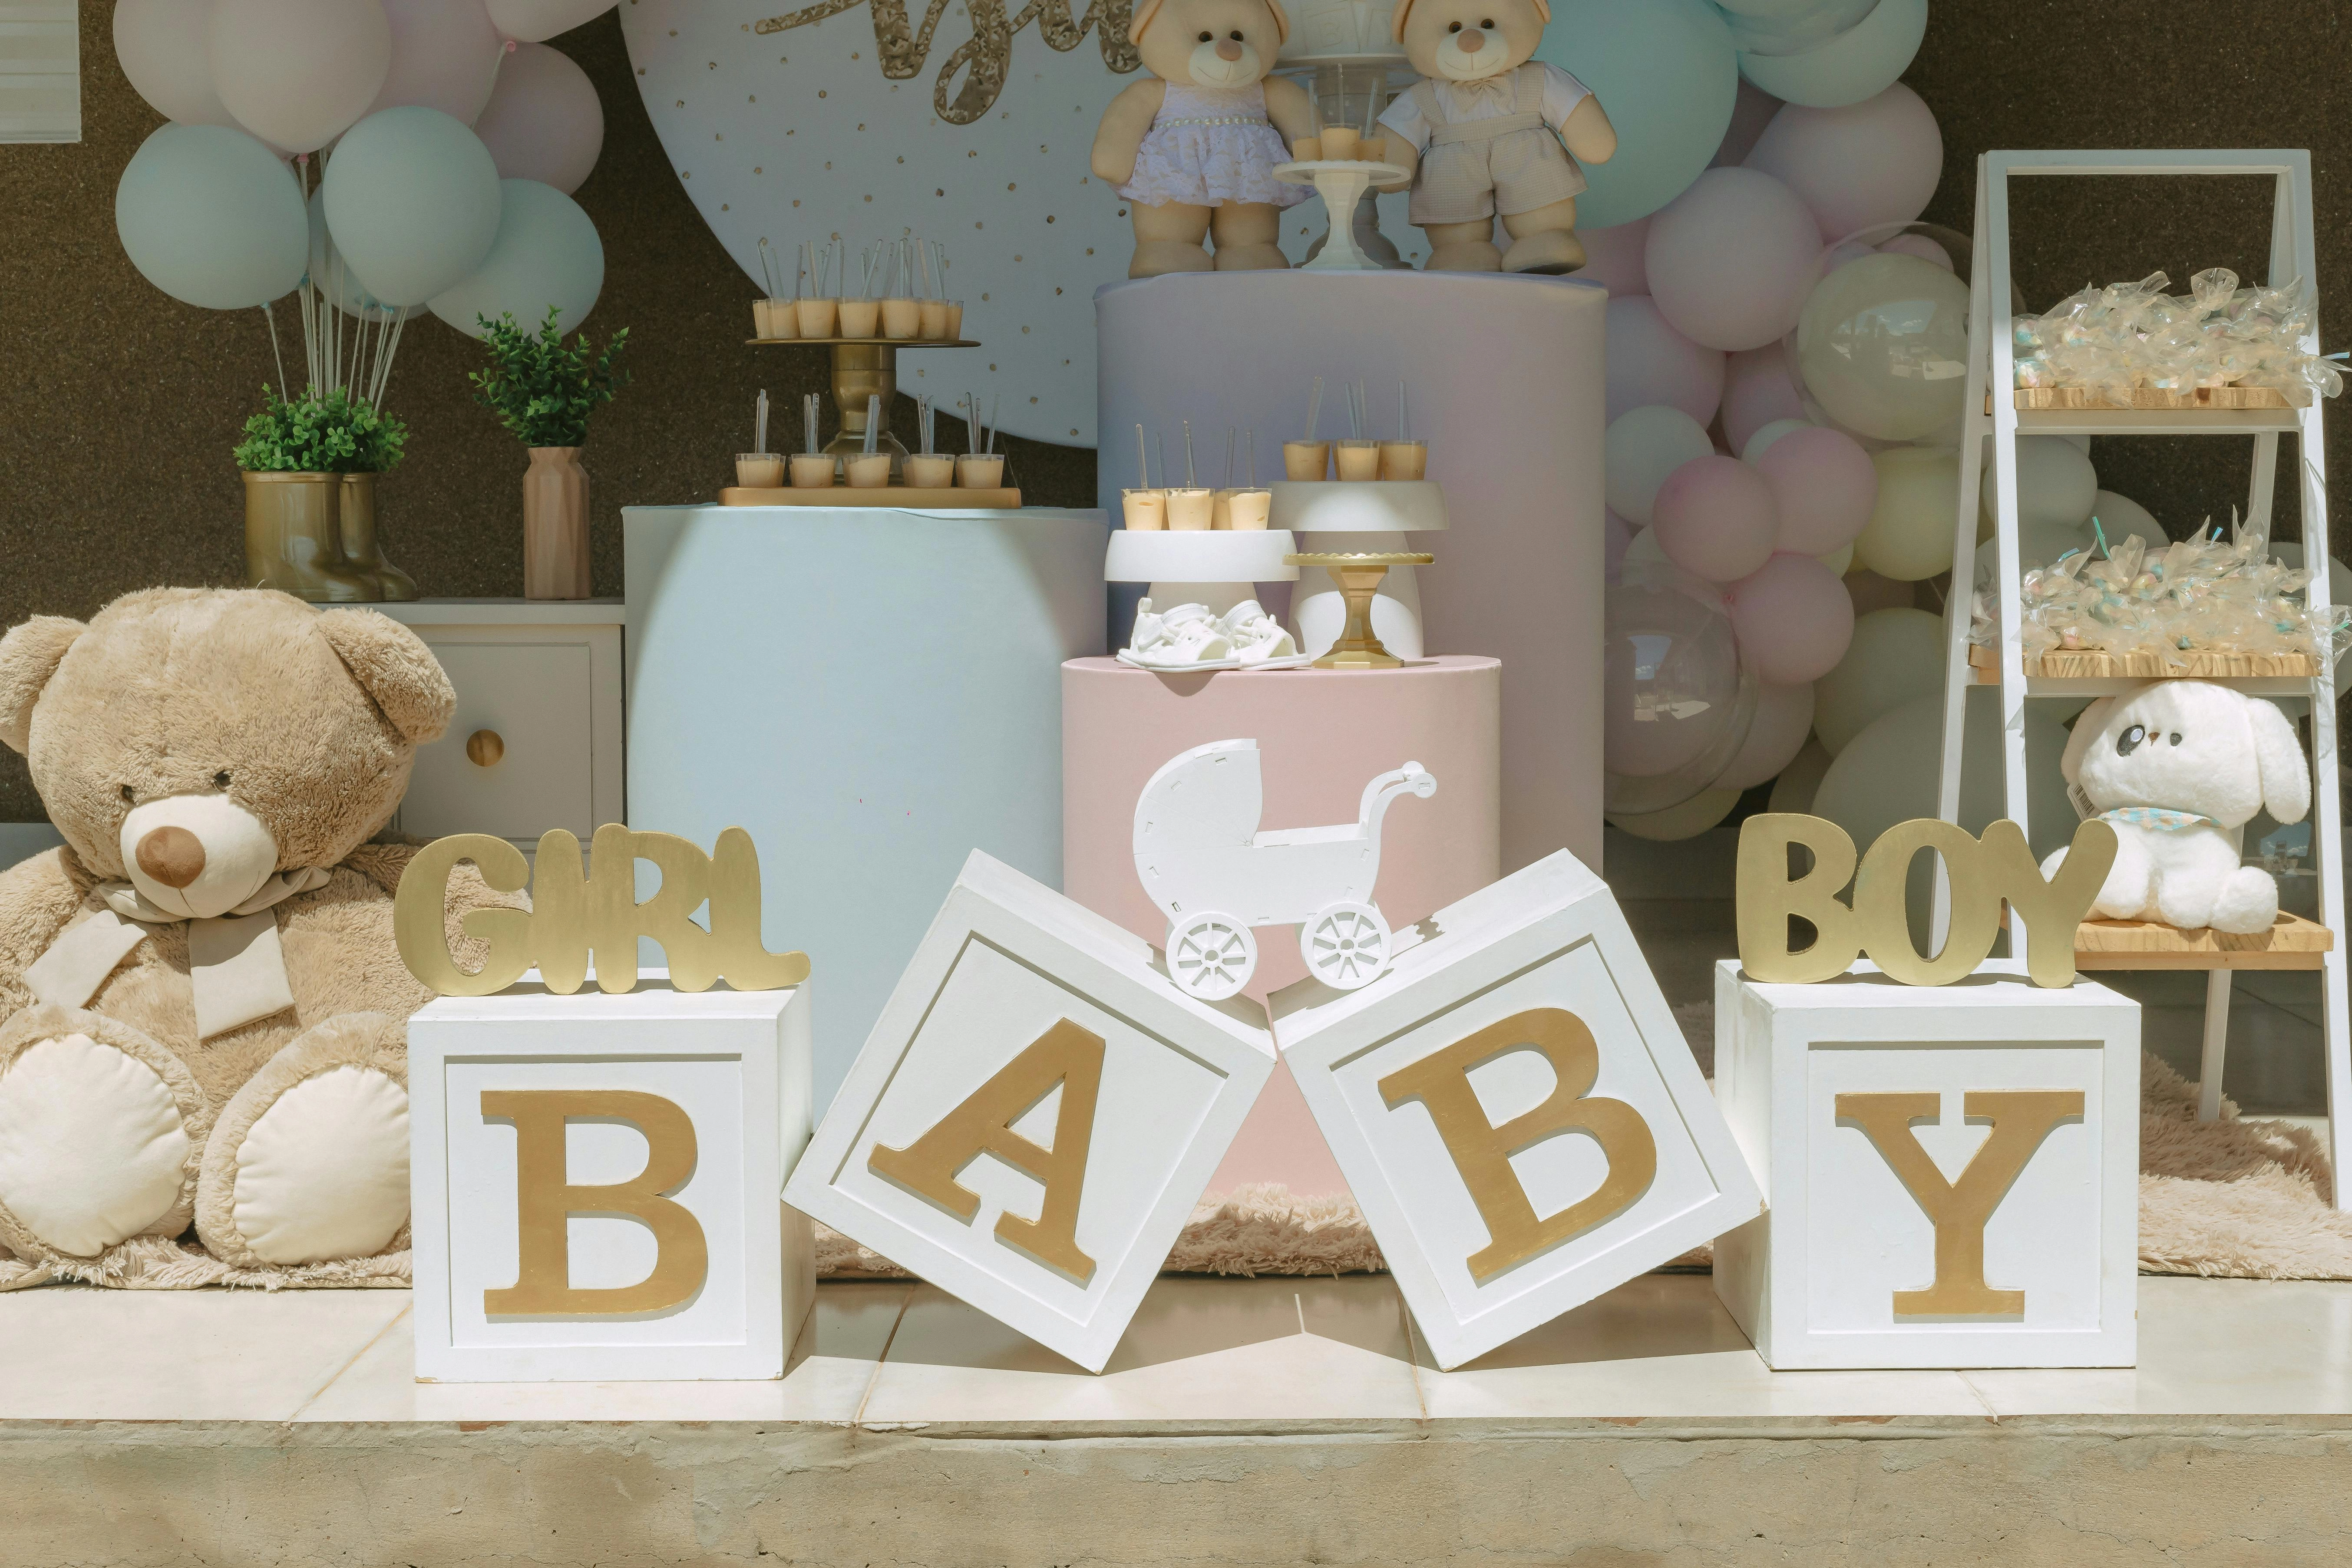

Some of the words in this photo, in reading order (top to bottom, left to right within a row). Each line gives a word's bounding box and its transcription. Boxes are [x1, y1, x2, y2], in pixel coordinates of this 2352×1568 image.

[393, 823, 811, 996] GIRL
[1737, 813, 2118, 988] BOY
[481, 1007, 2085, 1315] BABY
